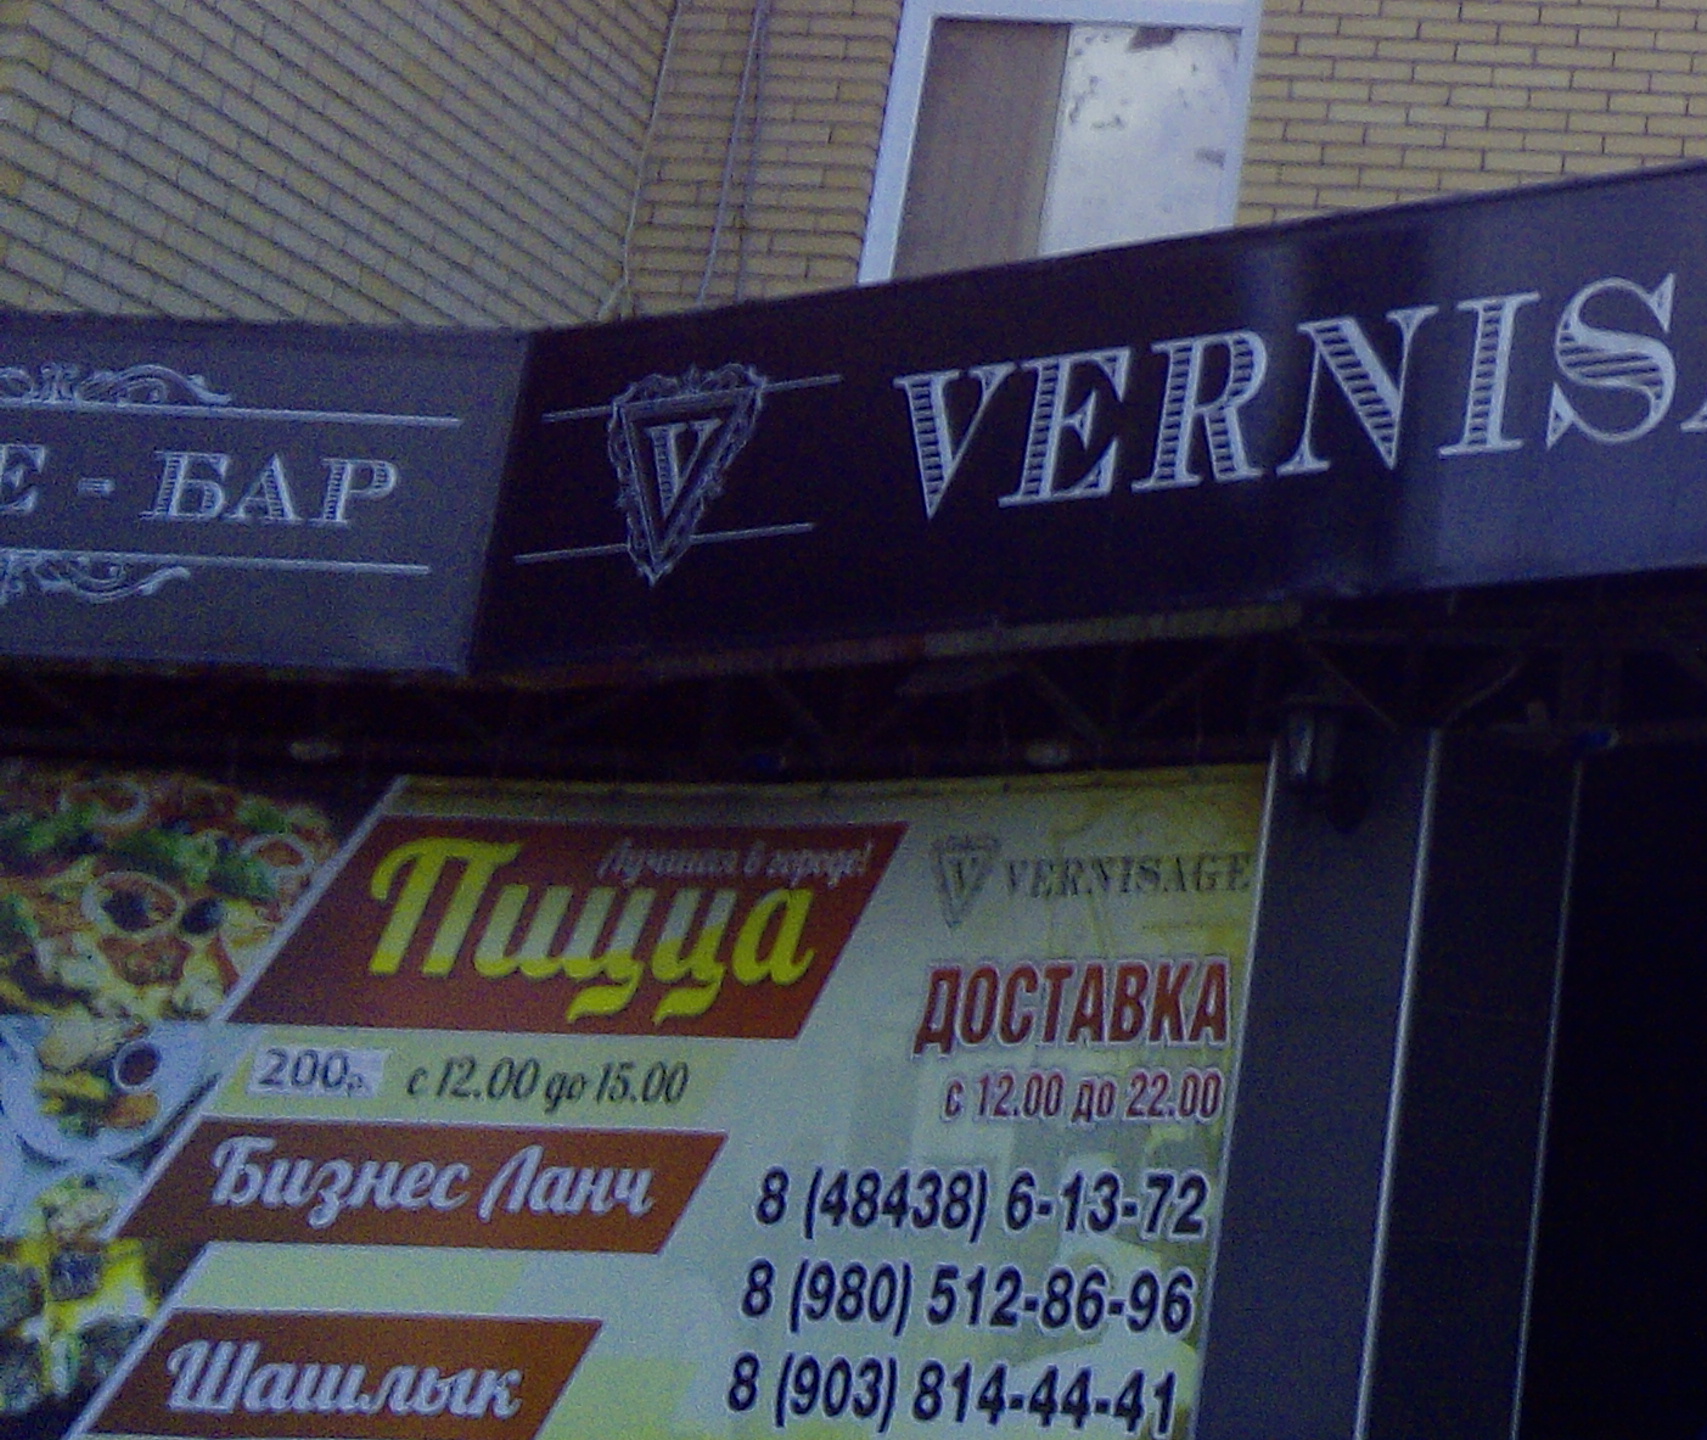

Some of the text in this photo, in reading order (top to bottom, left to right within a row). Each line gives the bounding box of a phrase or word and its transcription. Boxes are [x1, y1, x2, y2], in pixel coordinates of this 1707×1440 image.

[138, 450, 399, 527] БАР
[1004, 851, 1252, 897] VERNISAGE
[369, 836, 815, 1025] Пицца
[912, 962, 1229, 1057] ДОСТАВКА
[406, 1055, 690, 1115] с 12.00 до 15.00
[945, 1069, 1223, 1123] с 12.00 до 22.00
[212, 1134, 656, 1230] Бизнес Ланч
[755, 1165, 1209, 1244] 8 (48438) 6-13-72
[741, 1258, 1195, 1338] 8 (980) 512-86-96
[165, 1339, 524, 1420] Шашлык
[728, 1352, 1176, 1436] 8 (903) 814-44-41
